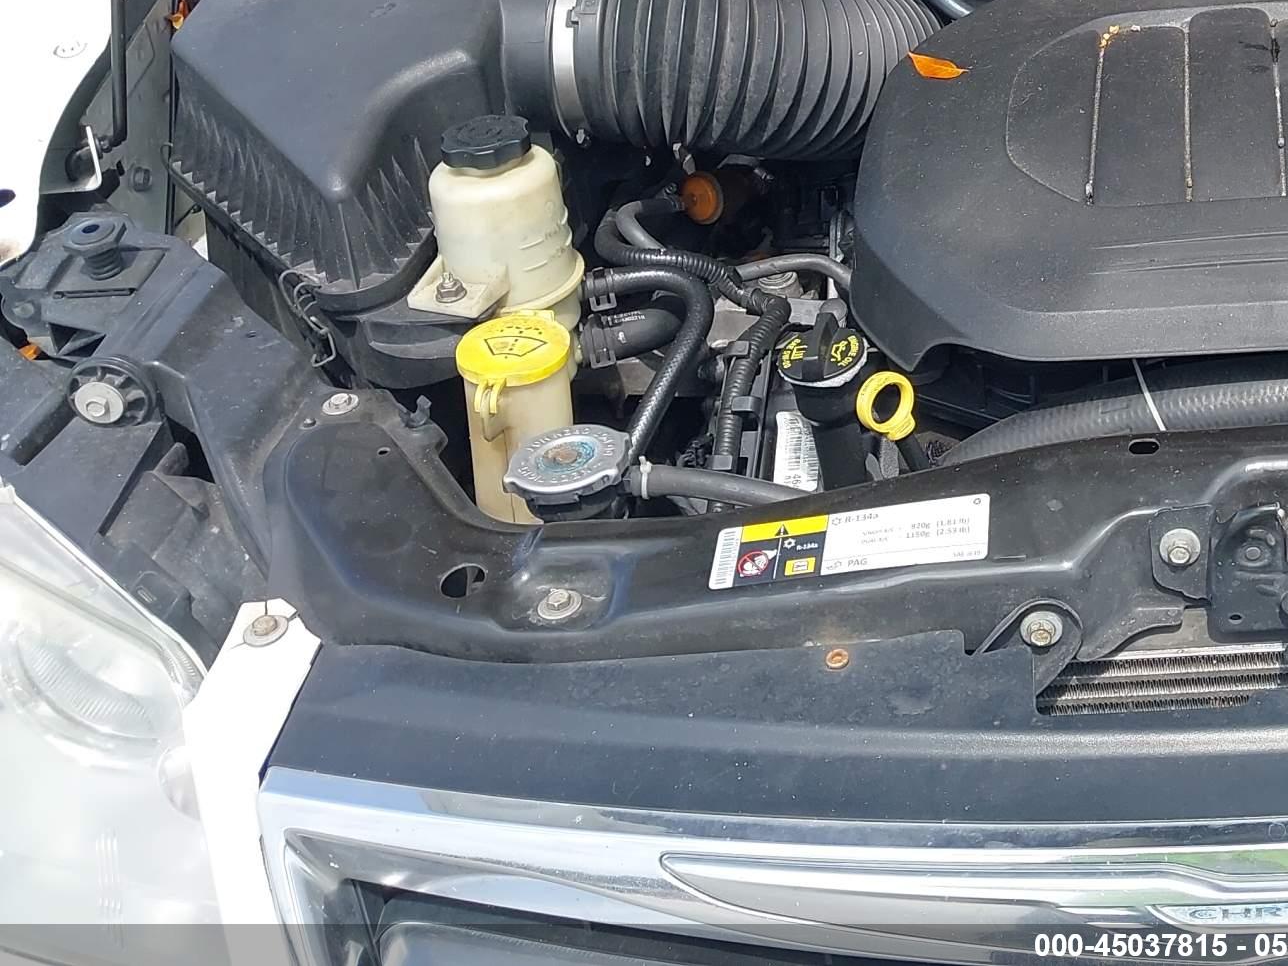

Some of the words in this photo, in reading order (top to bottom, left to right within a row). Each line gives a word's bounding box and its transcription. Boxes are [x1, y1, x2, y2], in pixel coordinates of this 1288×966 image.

[837, 356, 853, 367] OIL
[845, 513, 879, 524] R-134a
[847, 558, 868, 568] PAG
